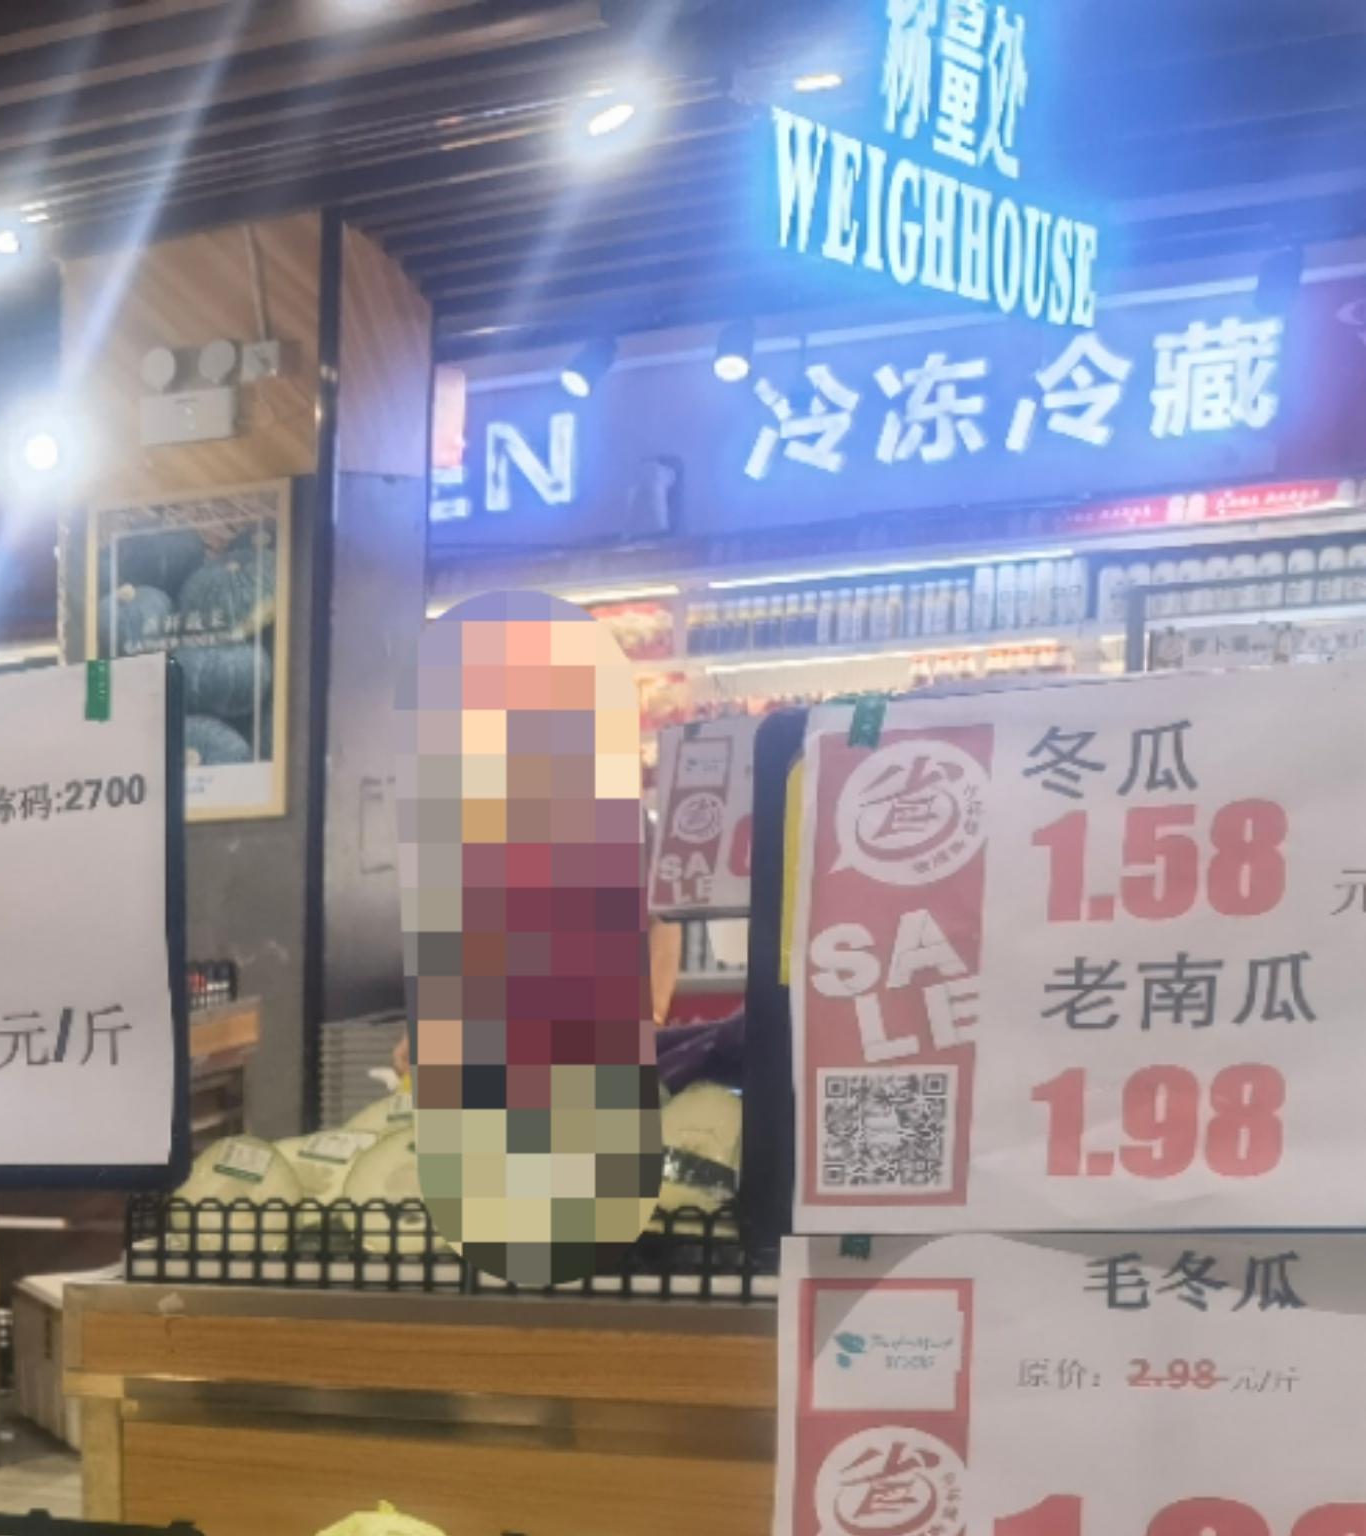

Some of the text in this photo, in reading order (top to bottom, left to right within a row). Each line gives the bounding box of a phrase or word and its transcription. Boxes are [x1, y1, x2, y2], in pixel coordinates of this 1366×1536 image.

[769, 105, 1099, 327] WEIGHHOUSE
[744, 316, 1282, 480] 冷冻冷藏
[1021, 720, 1199, 799] 冬瓜
[1030, 798, 1289, 923] 1.58
[1040, 951, 1319, 1031] 老南瓜
[1030, 1062, 1287, 1180] 1.98
[1083, 1249, 1307, 1312] 毛冬瓜
[1126, 1358, 1222, 1391] 2.98
